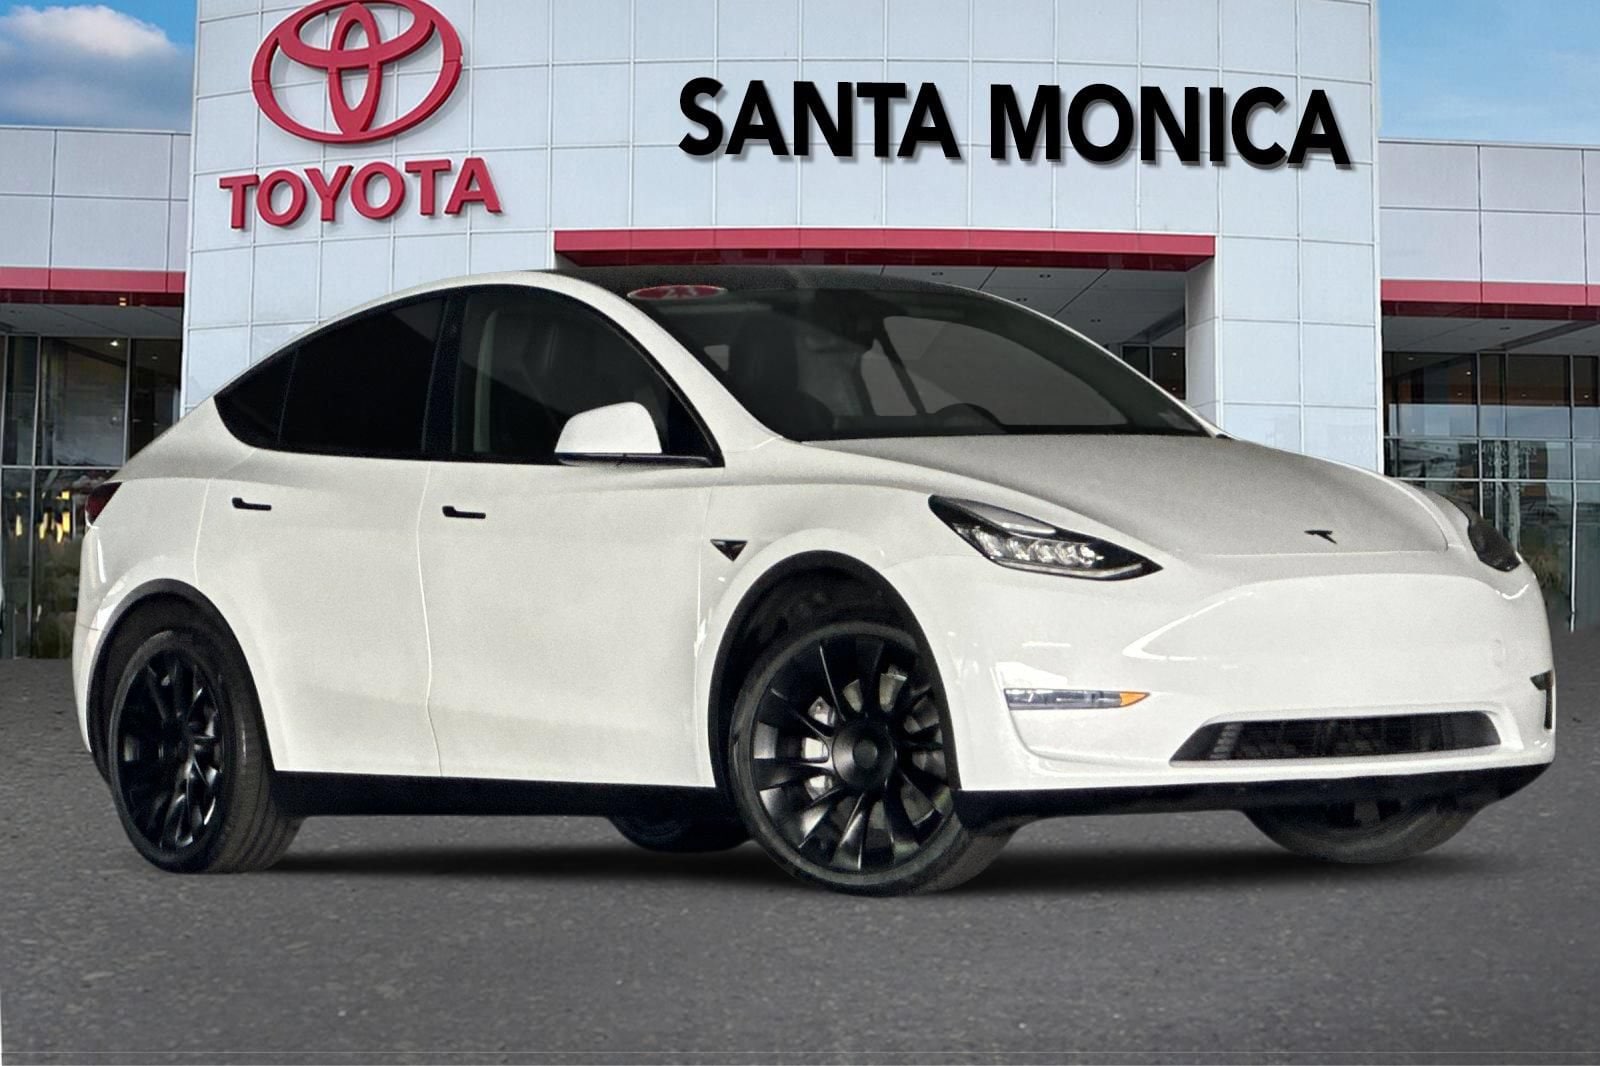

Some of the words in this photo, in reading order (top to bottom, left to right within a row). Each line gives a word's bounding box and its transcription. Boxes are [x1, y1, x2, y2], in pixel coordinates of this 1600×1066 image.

[679, 78, 961, 158] SANTA
[991, 84, 1350, 168] MONICA
[220, 158, 502, 229] TOYOTA
